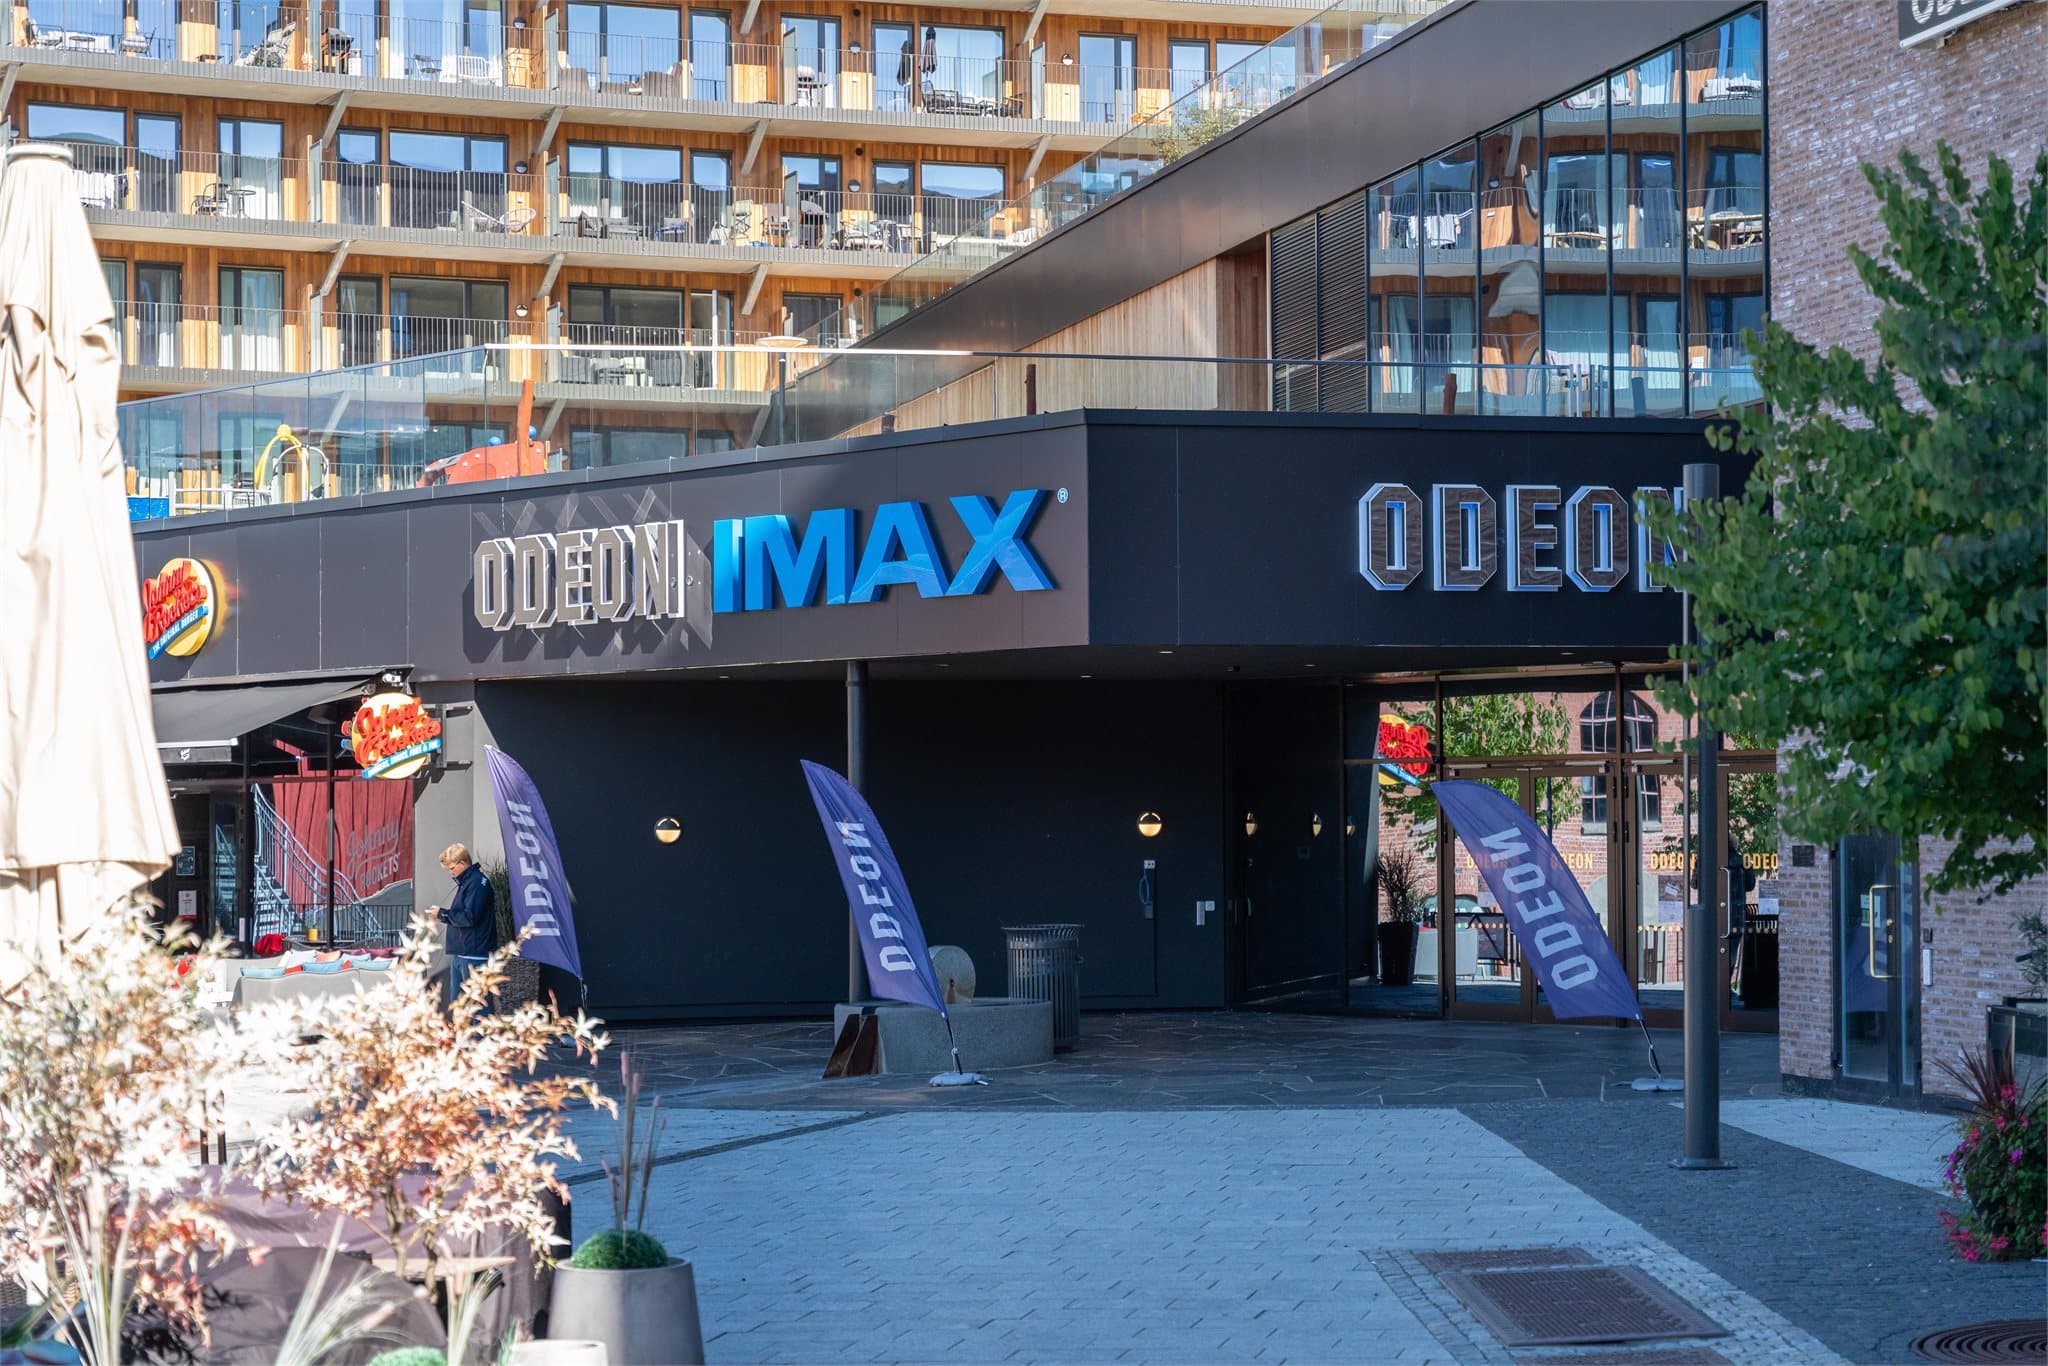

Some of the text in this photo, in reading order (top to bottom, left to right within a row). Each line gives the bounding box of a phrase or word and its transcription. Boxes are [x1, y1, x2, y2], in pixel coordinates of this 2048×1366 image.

[143, 560, 192, 612] Johnny
[474, 519, 685, 631] ODEON
[143, 576, 208, 643] Rockets
[354, 715, 441, 766] Rockets
[355, 696, 421, 738] Johnny
[346, 818, 400, 881] Johnny
[360, 852, 400, 891] ROCKETS
[507, 800, 560, 936] ODEON
[1743, 852, 1779, 869] ODEO
[835, 821, 916, 962] ODEON
[1480, 827, 1599, 990] ODEON
